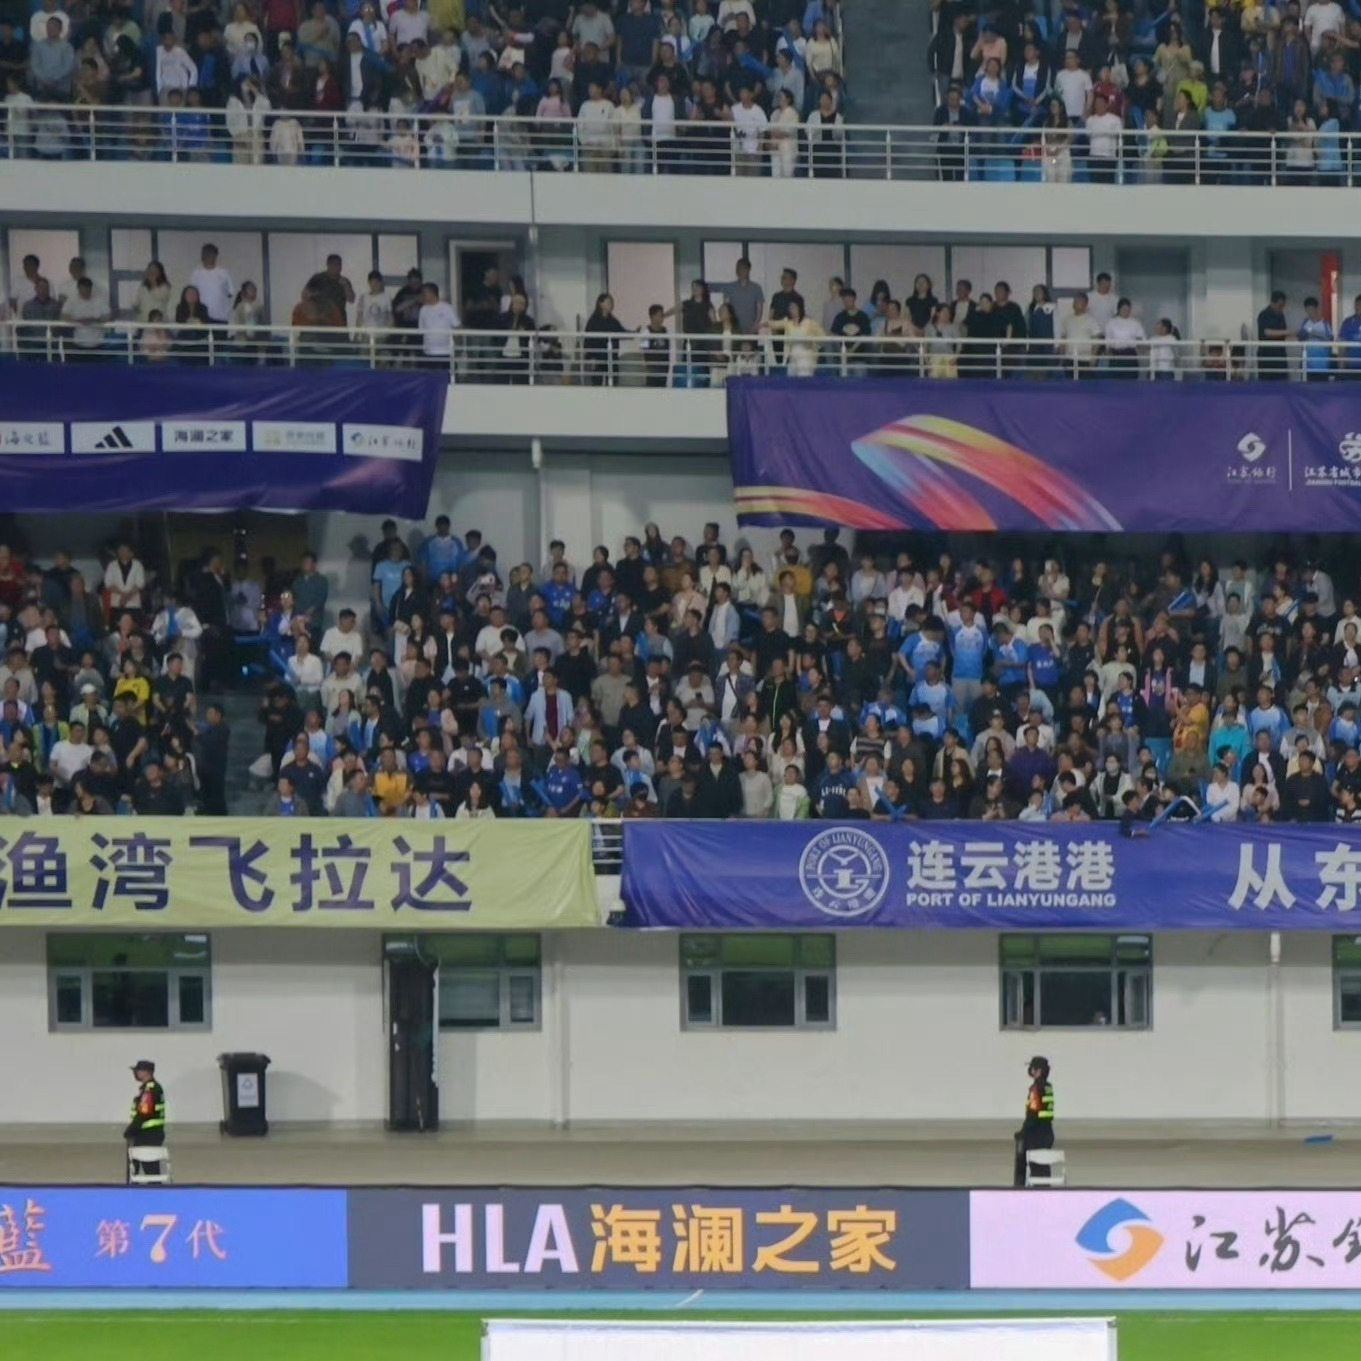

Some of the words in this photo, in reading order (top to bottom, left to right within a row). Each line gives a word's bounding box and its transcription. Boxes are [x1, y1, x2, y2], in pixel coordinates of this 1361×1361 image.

[0, 831, 473, 912] 渔湾飞拉达
[907, 839, 1116, 891] 连云港港
[906, 893, 951, 908] PORT
[958, 893, 981, 908] OF
[987, 893, 1116, 908] LIANYUNGANG
[95, 1212, 227, 1261] 第7代
[423, 1203, 580, 1273] HLA
[590, 1203, 899, 1274] 海澜之家
